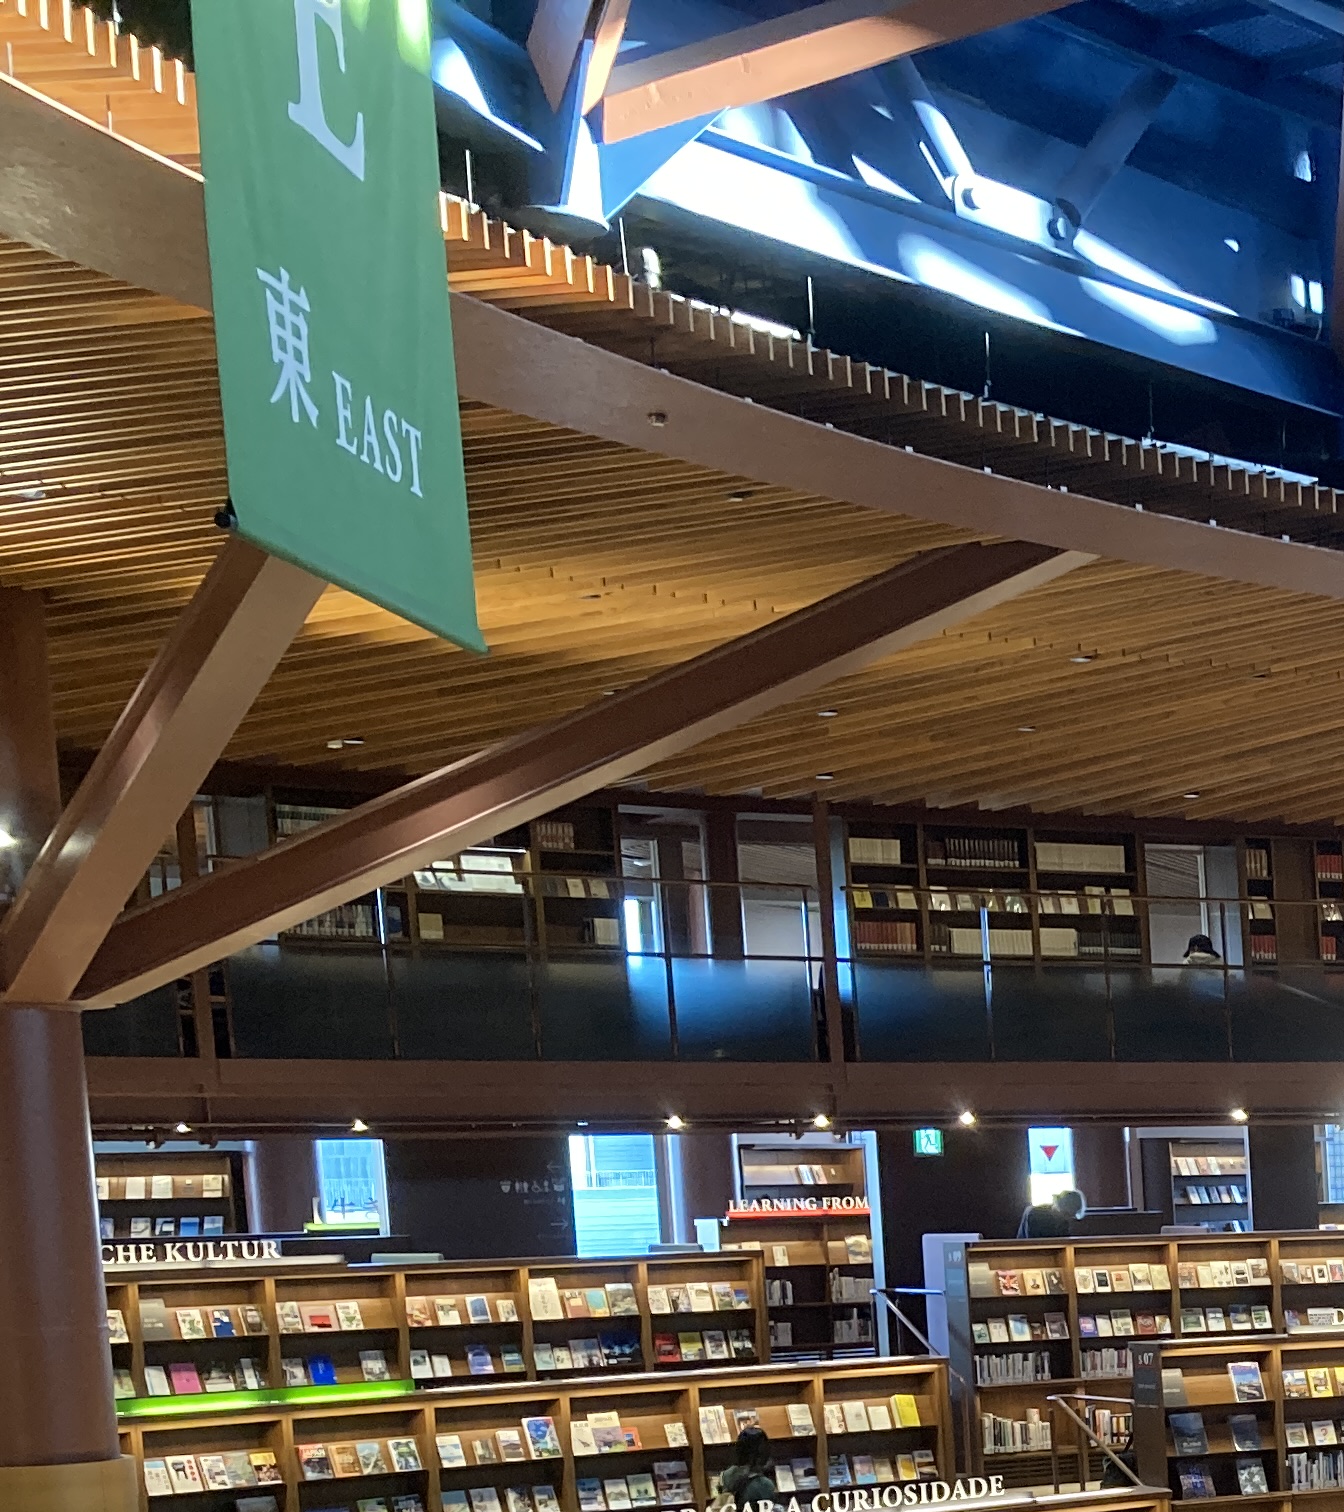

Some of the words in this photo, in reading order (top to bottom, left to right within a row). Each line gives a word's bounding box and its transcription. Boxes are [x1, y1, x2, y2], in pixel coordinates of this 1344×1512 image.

[256, 267, 319, 429] 東
[332, 370, 425, 499] EAST
[728, 1197, 818, 1213] LEARNING
[822, 1196, 869, 1210] FROM
[164, 1240, 282, 1263] KULTUR
